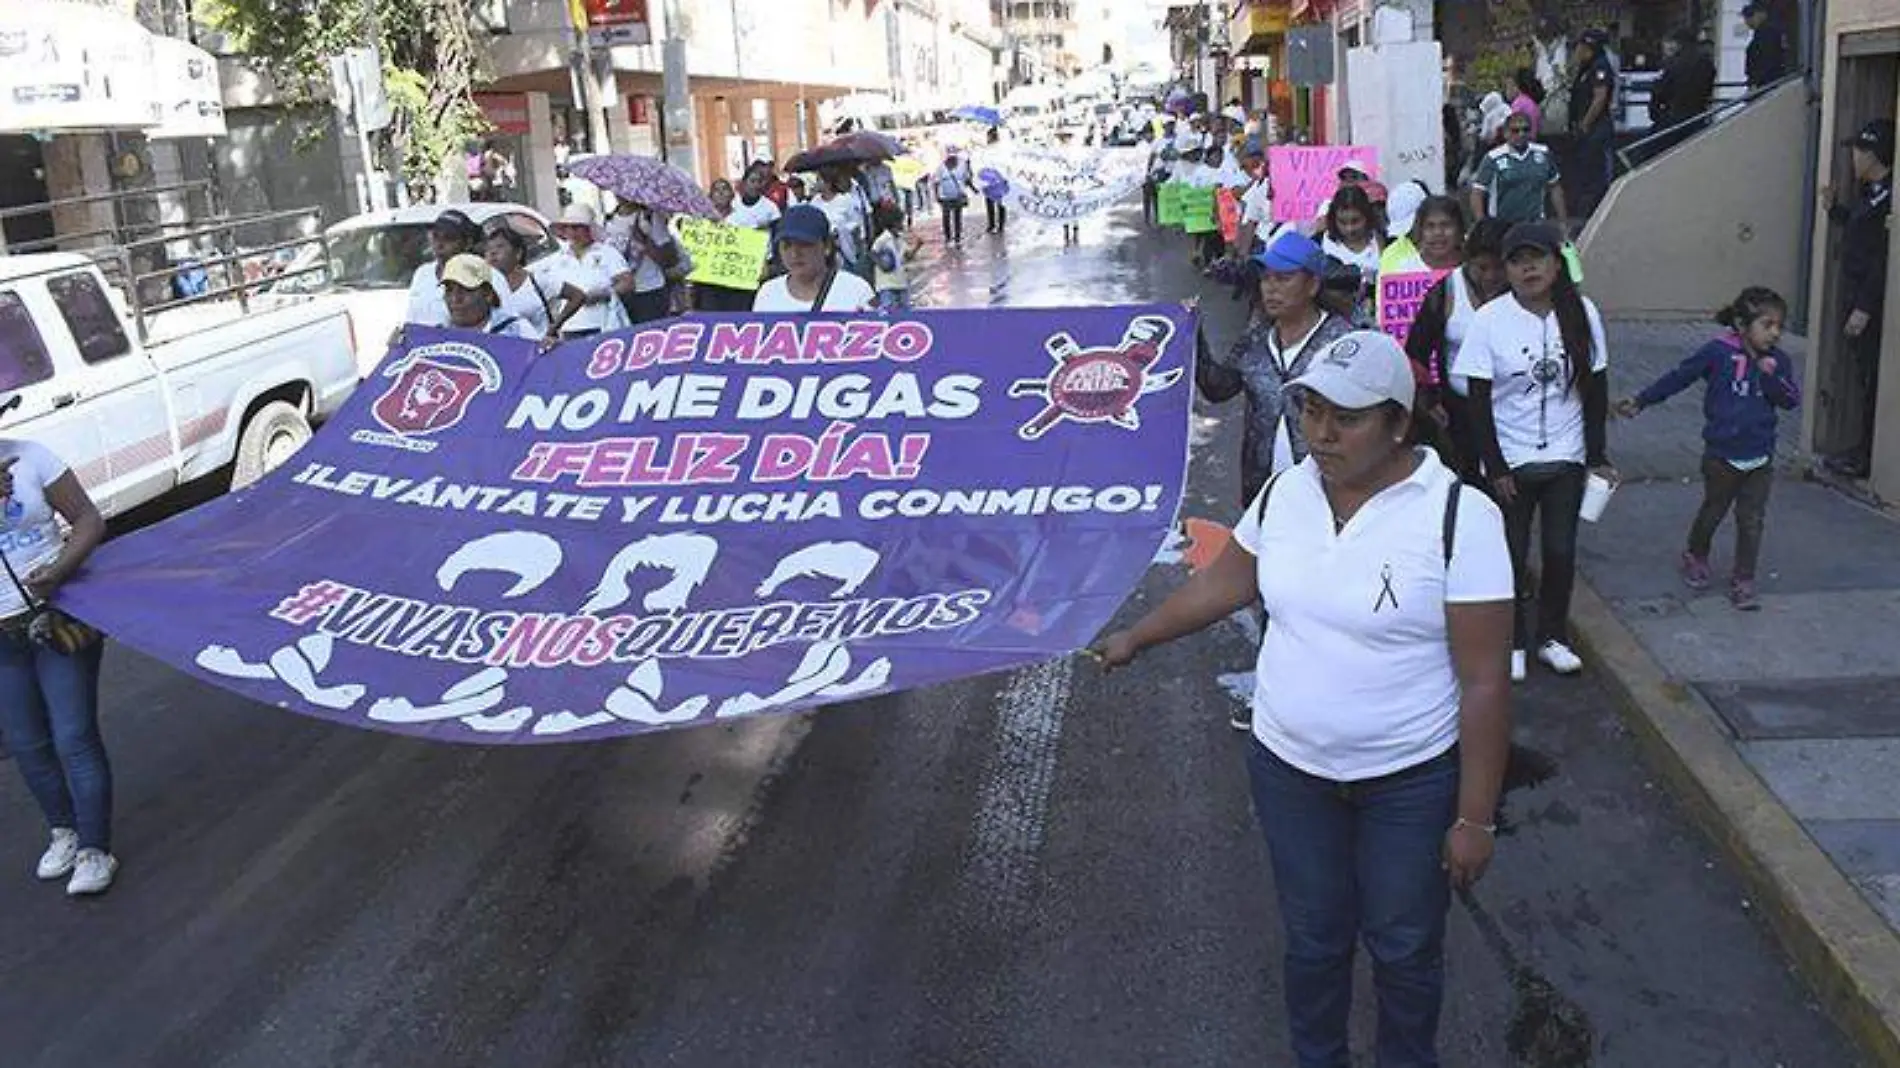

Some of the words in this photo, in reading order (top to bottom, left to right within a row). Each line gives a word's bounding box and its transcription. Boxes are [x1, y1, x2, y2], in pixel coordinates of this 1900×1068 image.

[587, 341, 621, 379] 8
[625, 323, 703, 371] DE
[706, 321, 933, 366] MARZO
[506, 390, 609, 431] NO
[618, 374, 727, 422] ME
[736, 372, 982, 420] DIGAS
[511, 431, 751, 487] ¡FELIZ
[750, 420, 930, 483] DÍA!
[291, 462, 613, 520] ¡LEVÁNTATE
[618, 496, 656, 523] Y
[658, 491, 841, 523] LUCHA
[859, 484, 1163, 519] CONMIGO!
